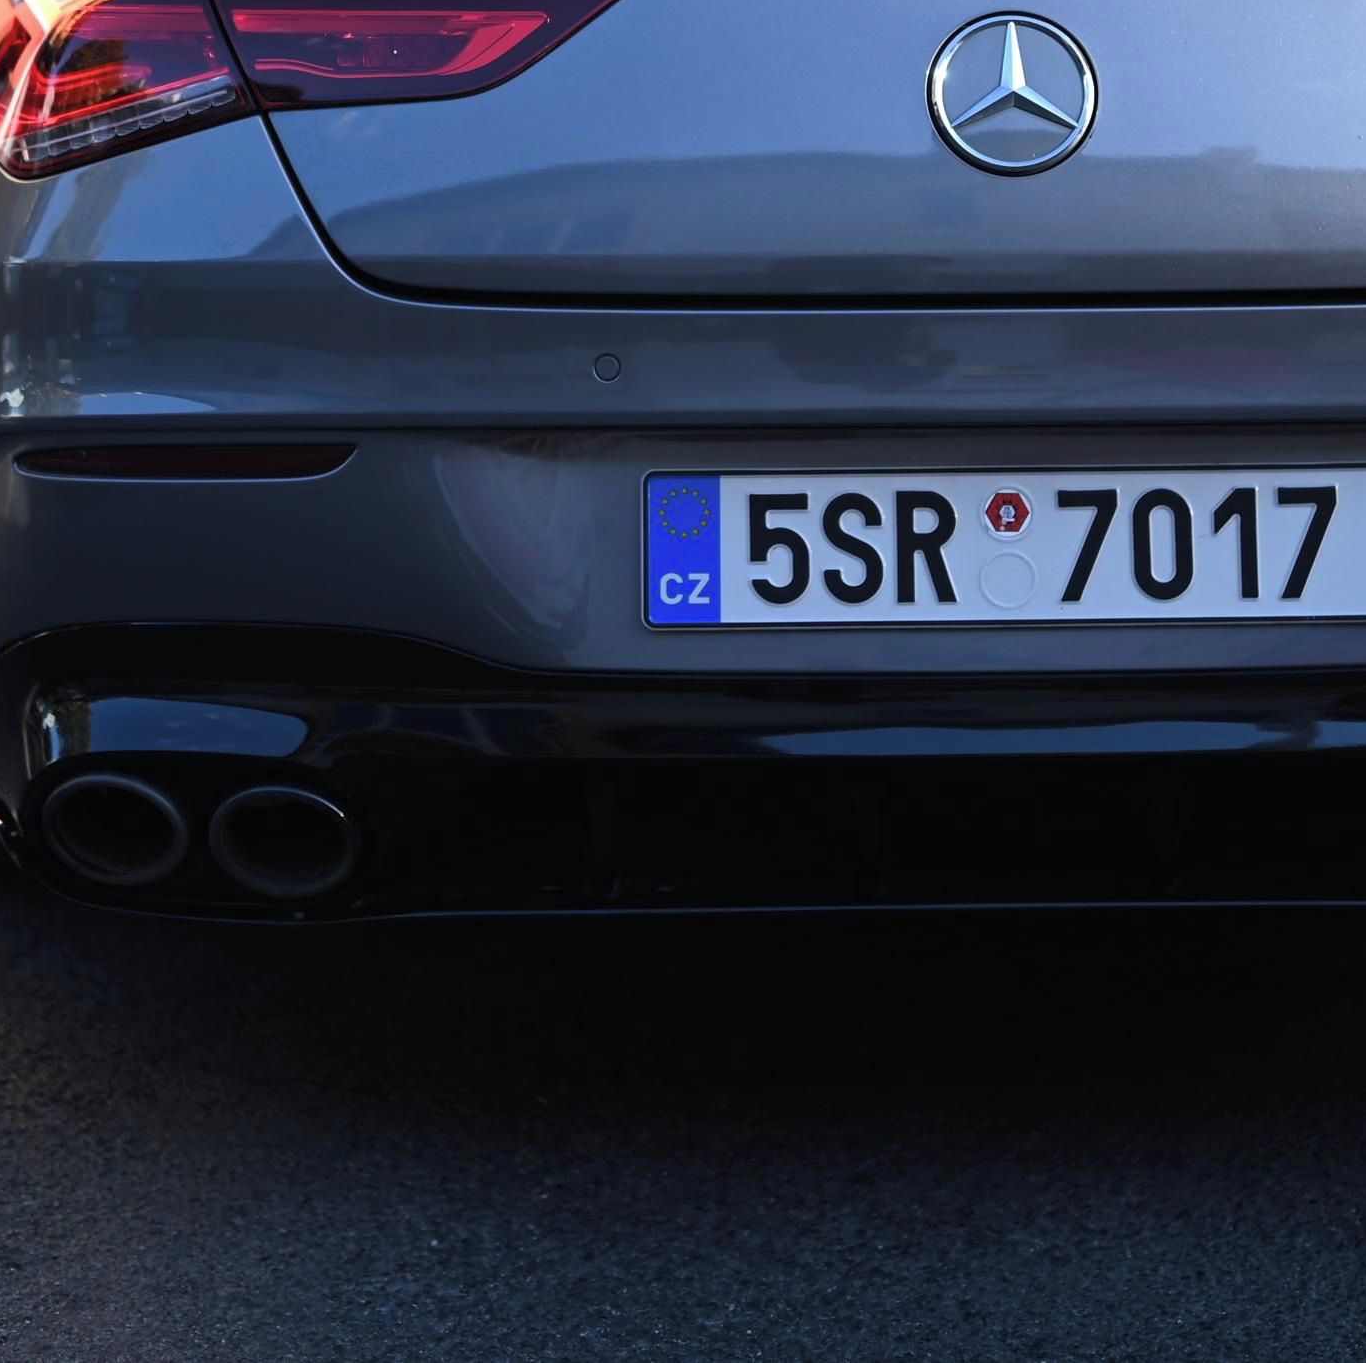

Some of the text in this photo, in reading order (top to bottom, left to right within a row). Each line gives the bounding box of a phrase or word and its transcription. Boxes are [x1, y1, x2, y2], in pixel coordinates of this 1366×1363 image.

[749, 485, 1338, 605] 5SR 7017
[659, 572, 711, 605] CZ
